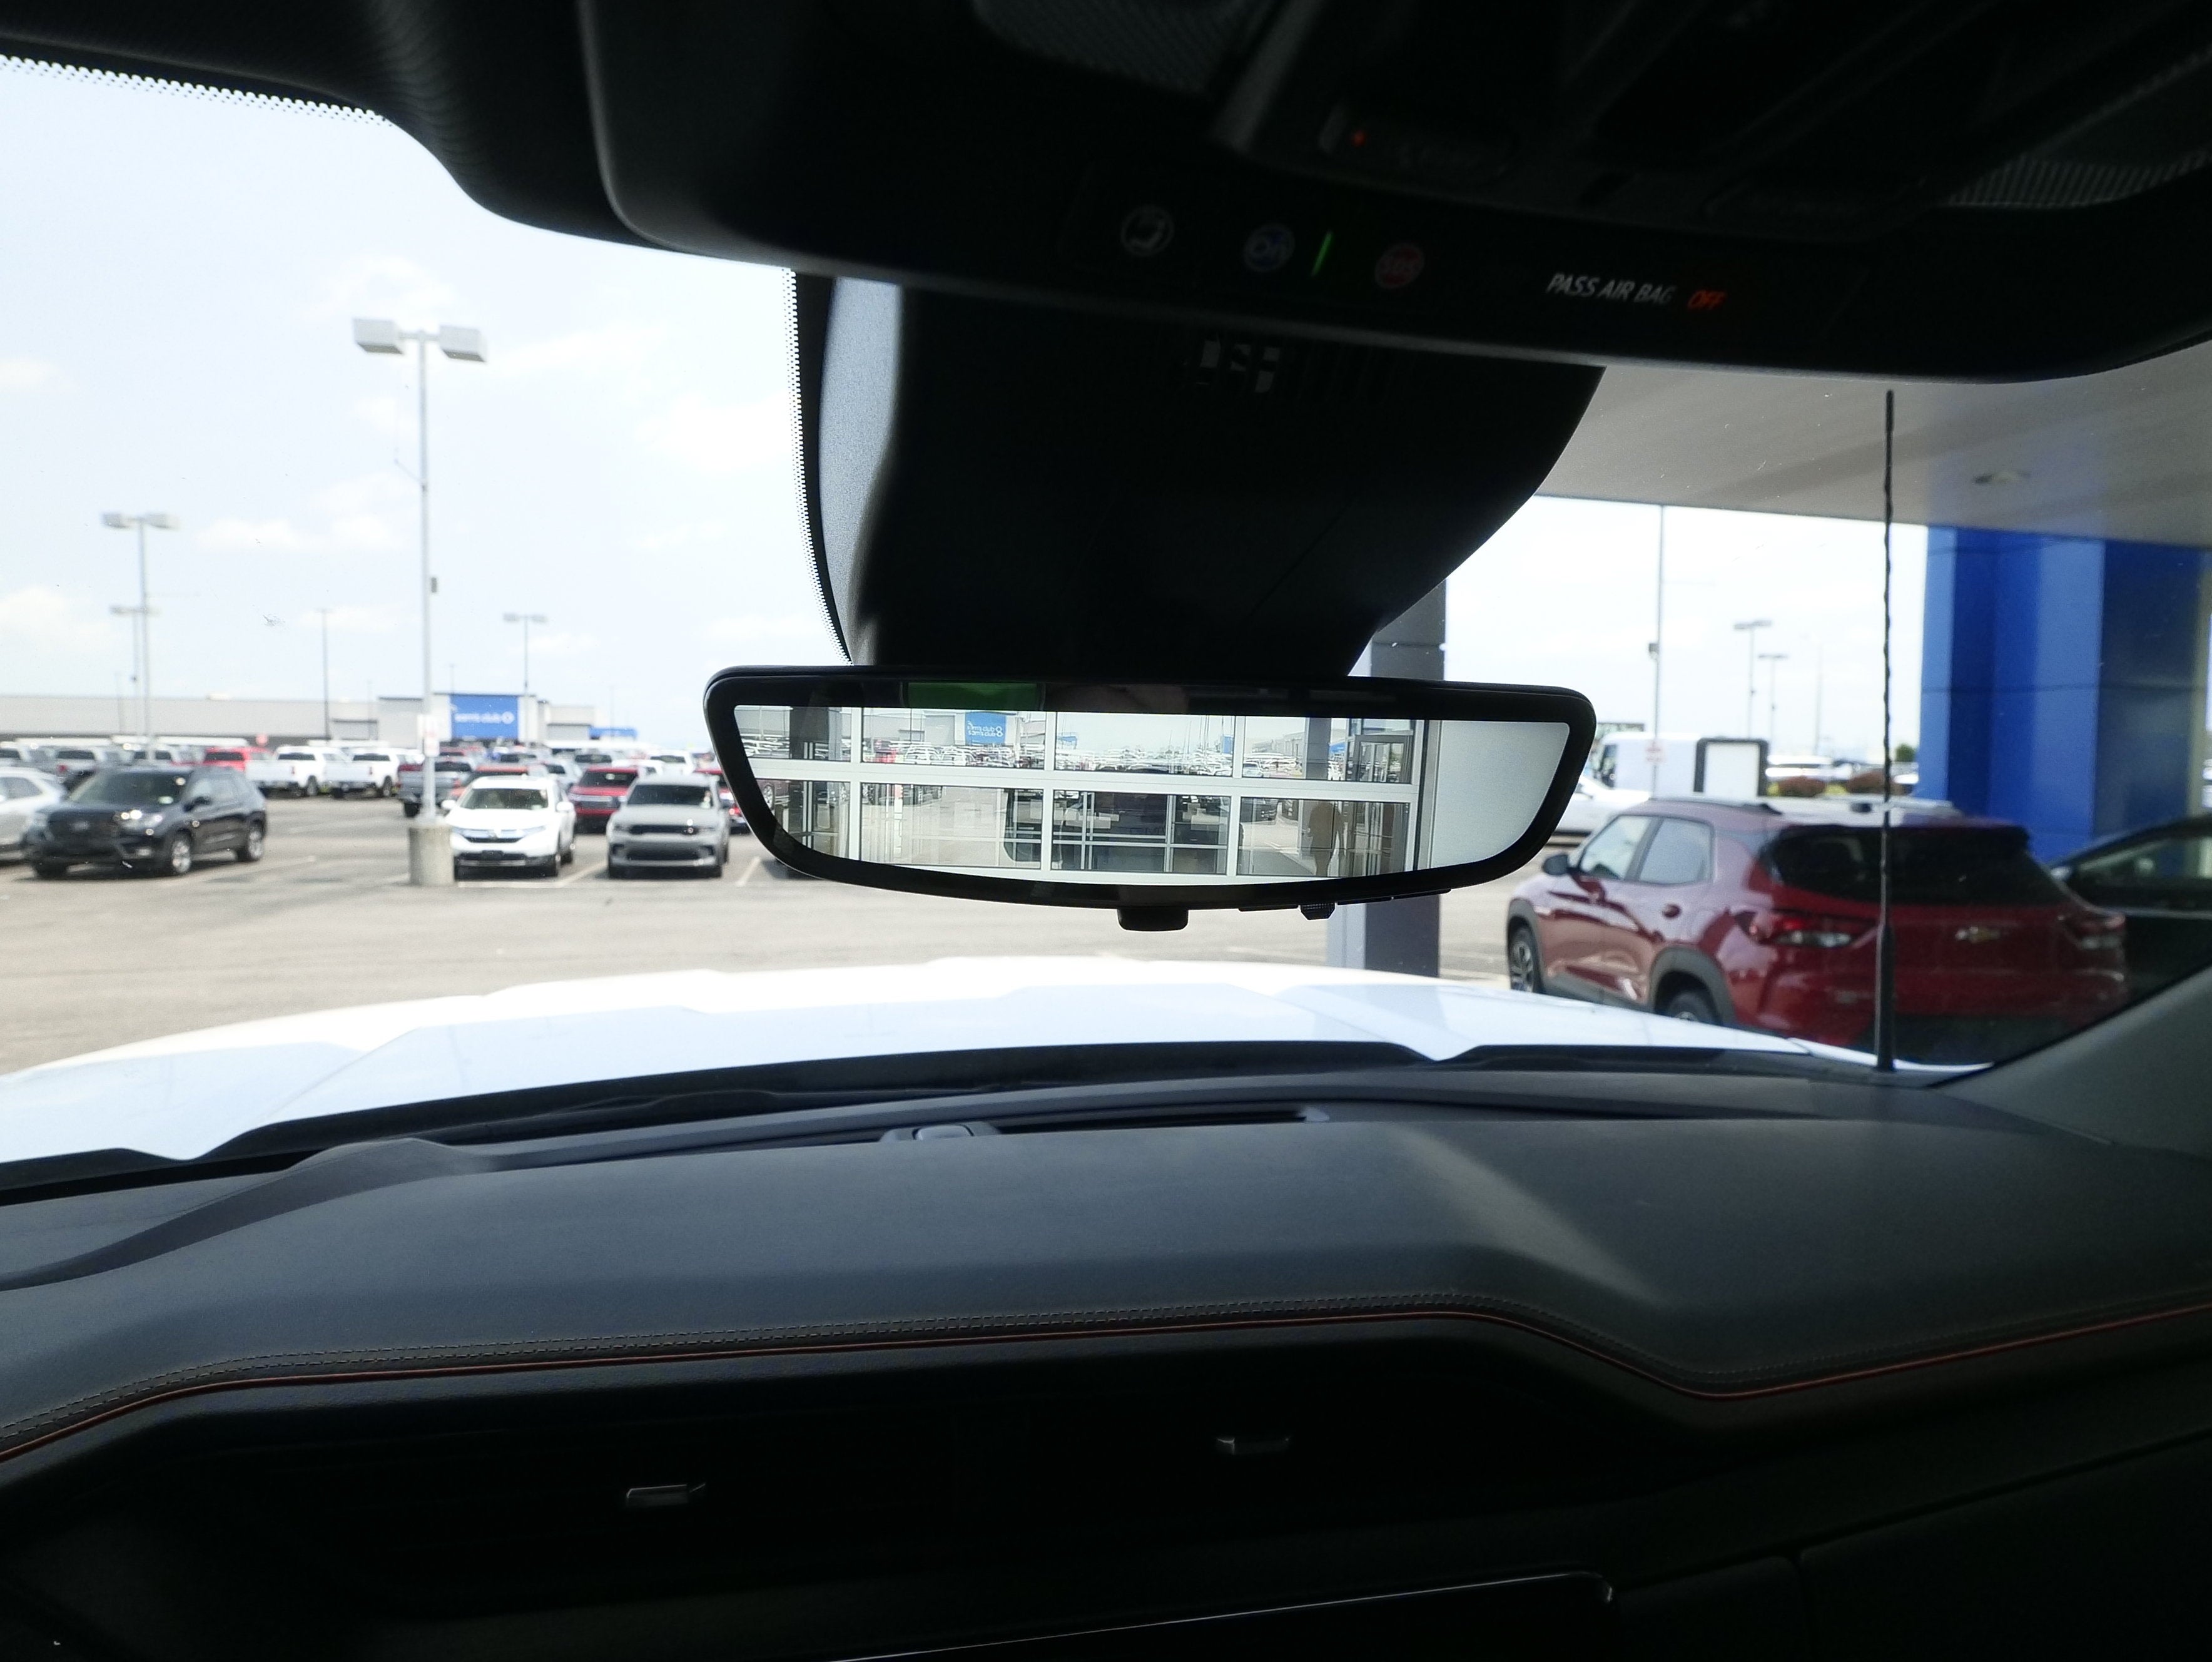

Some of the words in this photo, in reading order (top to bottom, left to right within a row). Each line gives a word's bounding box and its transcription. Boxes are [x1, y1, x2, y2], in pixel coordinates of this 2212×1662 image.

[1546, 273, 1600, 297] PASS
[1597, 280, 1635, 301] AIR
[1633, 283, 1677, 305] BAG
[1687, 290, 1727, 310] OFF
